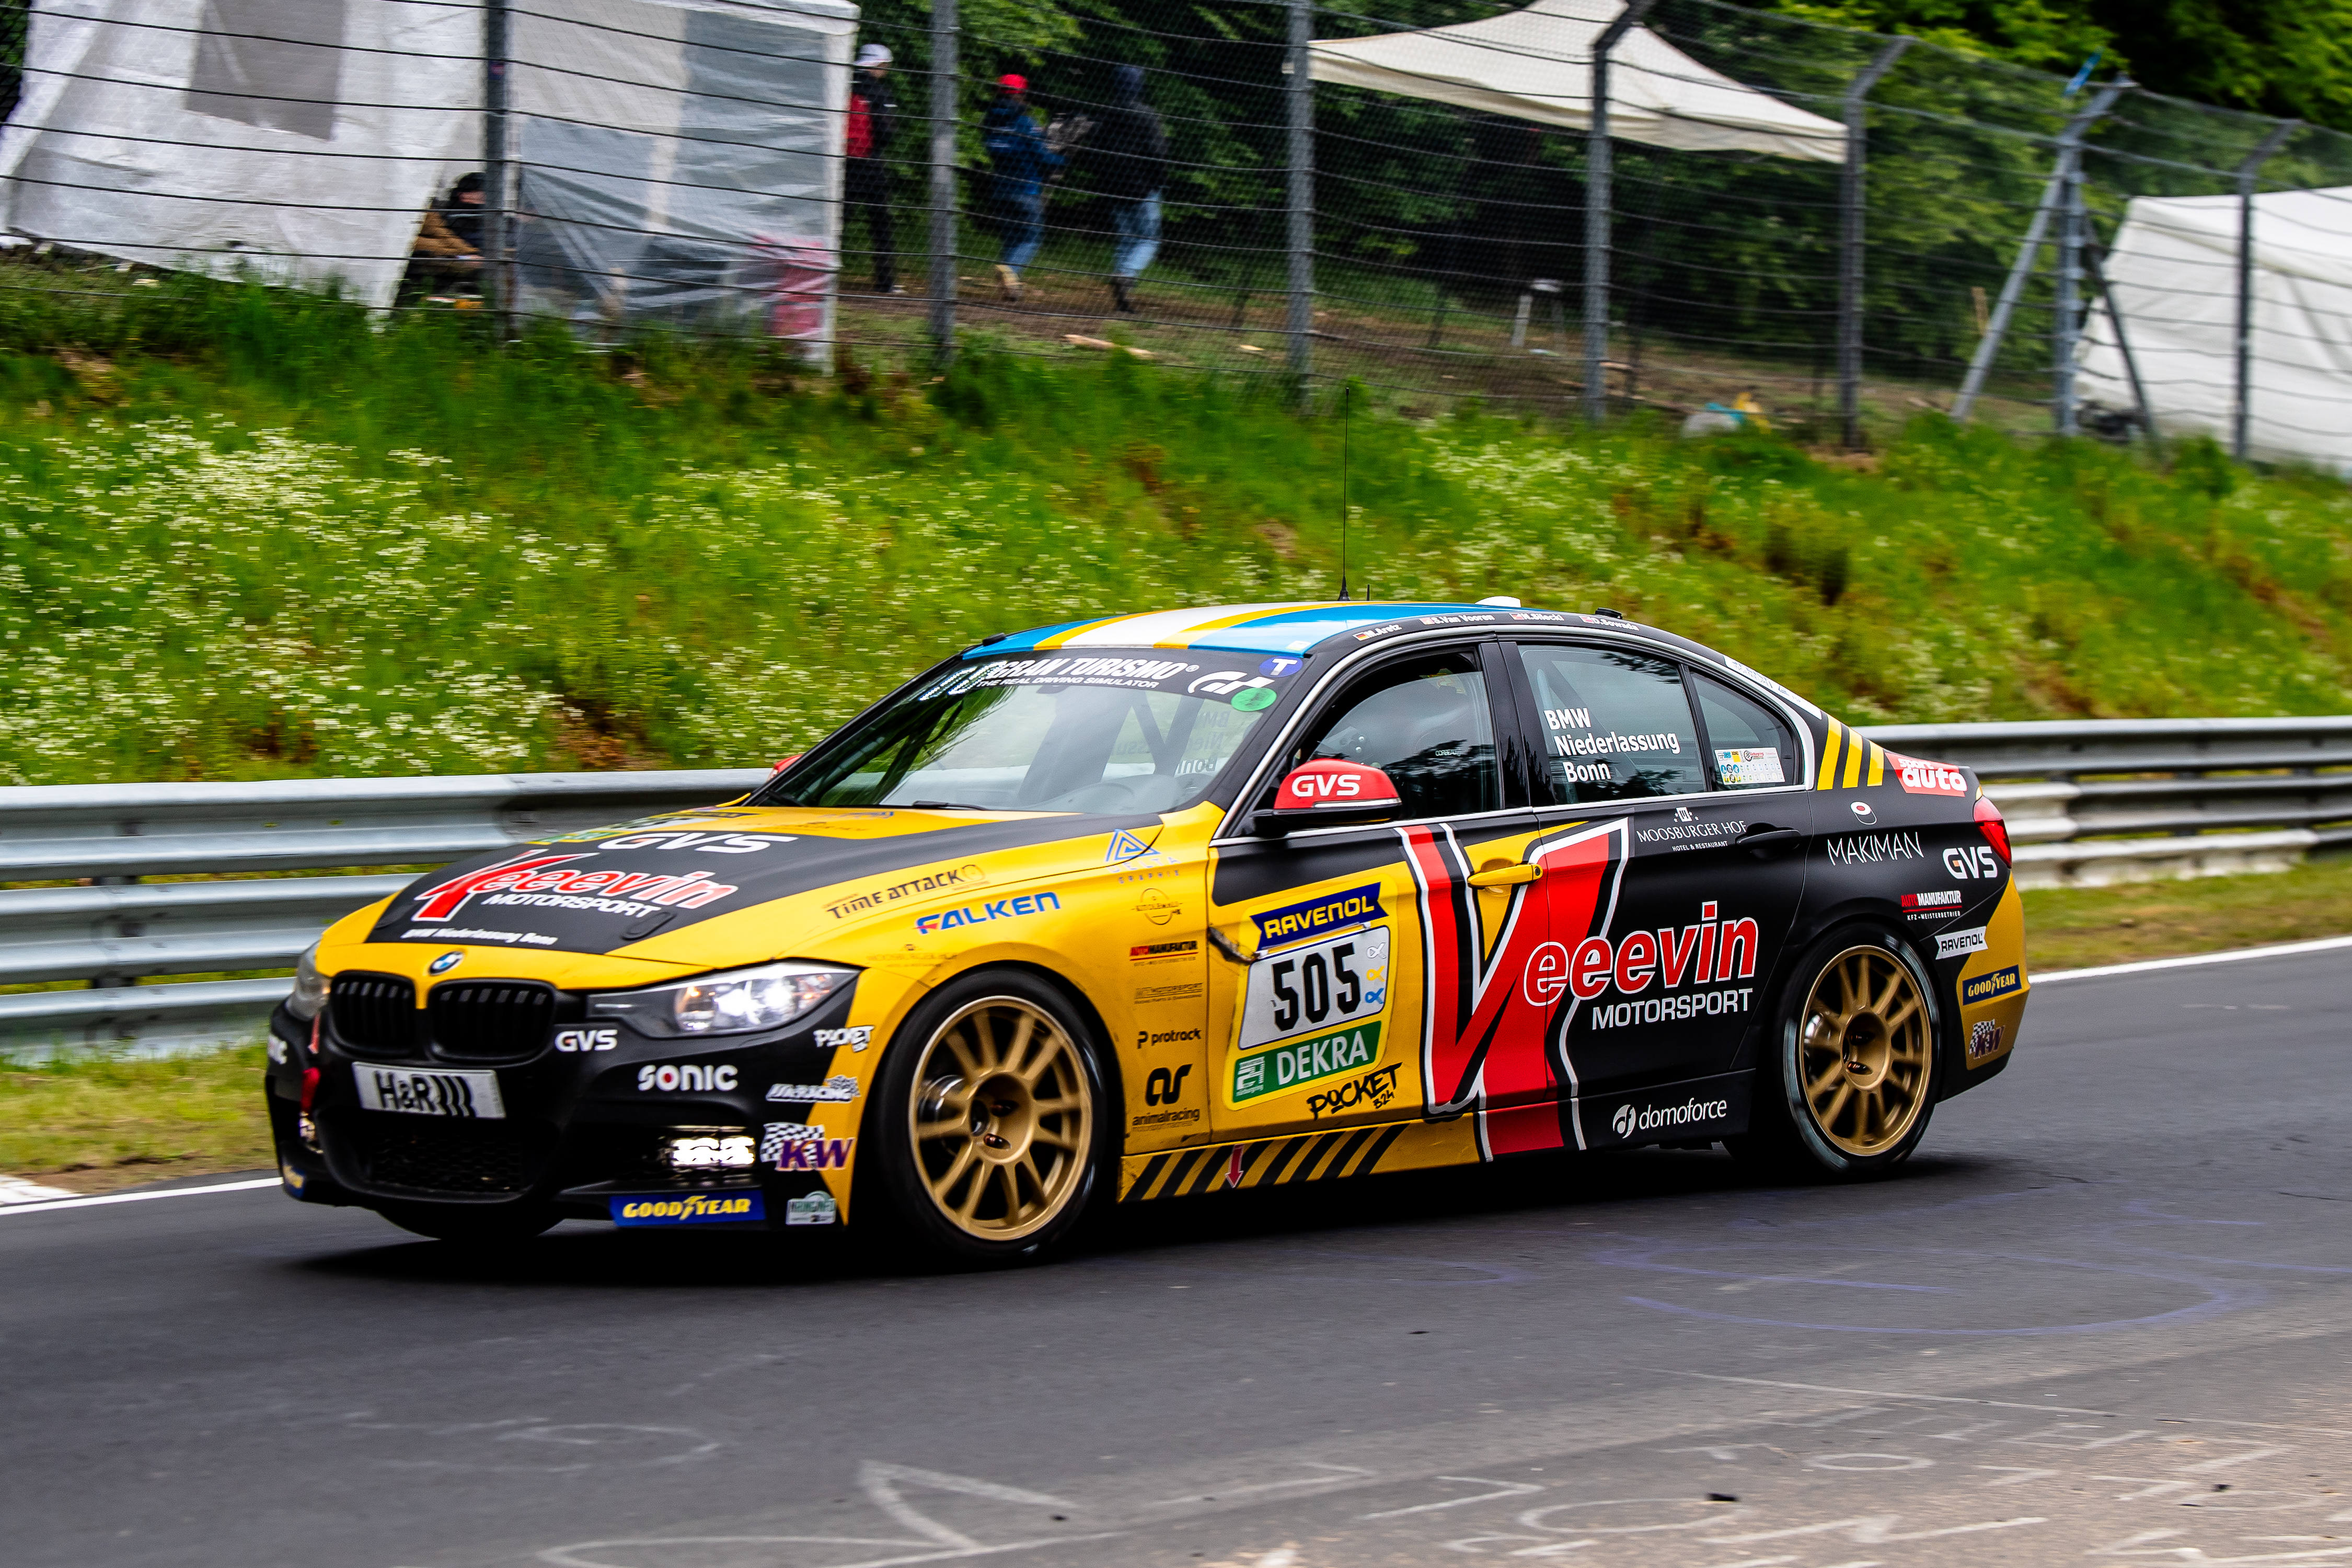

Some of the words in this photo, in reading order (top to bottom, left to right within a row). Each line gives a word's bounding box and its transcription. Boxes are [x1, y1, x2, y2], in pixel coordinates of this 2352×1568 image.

[1460, 614, 1495, 622] Vooren
[986, 659, 1062, 679] GRAN
[1001, 678, 1031, 687] REAL
[1083, 678, 1159, 688] SIMULATOR
[1543, 707, 1591, 730] BMW
[1553, 732, 1680, 757] Niederlassung
[1562, 761, 1611, 782] Bonn
[1898, 758, 1934, 769] sport
[1292, 774, 1361, 797] GVS
[1901, 767, 1968, 792] auto
[597, 832, 799, 854] GVS
[1636, 823, 1722, 843] MOOSBURGER
[1720, 820, 1747, 834] HOF
[1696, 840, 1728, 849] RESTAURANT
[1827, 831, 1924, 866] MAKIMAN
[1942, 846, 1998, 880] GVS
[481, 894, 662, 918] MOTORSPORT
[1900, 890, 1962, 907] AUTOMANUFAKTUR
[914, 891, 1062, 935] FALKEN
[1263, 895, 1375, 939] RAVENOL
[1941, 933, 1983, 953] RAVENOL
[1271, 942, 1361, 1032] 505
[1968, 973, 2016, 997] GOODYEAR
[1592, 988, 1754, 1030] MOTORSPORT
[555, 1029, 618, 1052] GVS
[1151, 1028, 1202, 1046] protrack
[1276, 1030, 1369, 1086] DEKRA
[637, 1065, 737, 1091] SONIC
[1306, 1062, 1403, 1121] POCKET
[1132, 1107, 1201, 1126] animalracing
[1639, 1097, 1727, 1130] domoforce
[775, 1137, 857, 1172] KW
[622, 1195, 751, 1221] GOODYEAR
